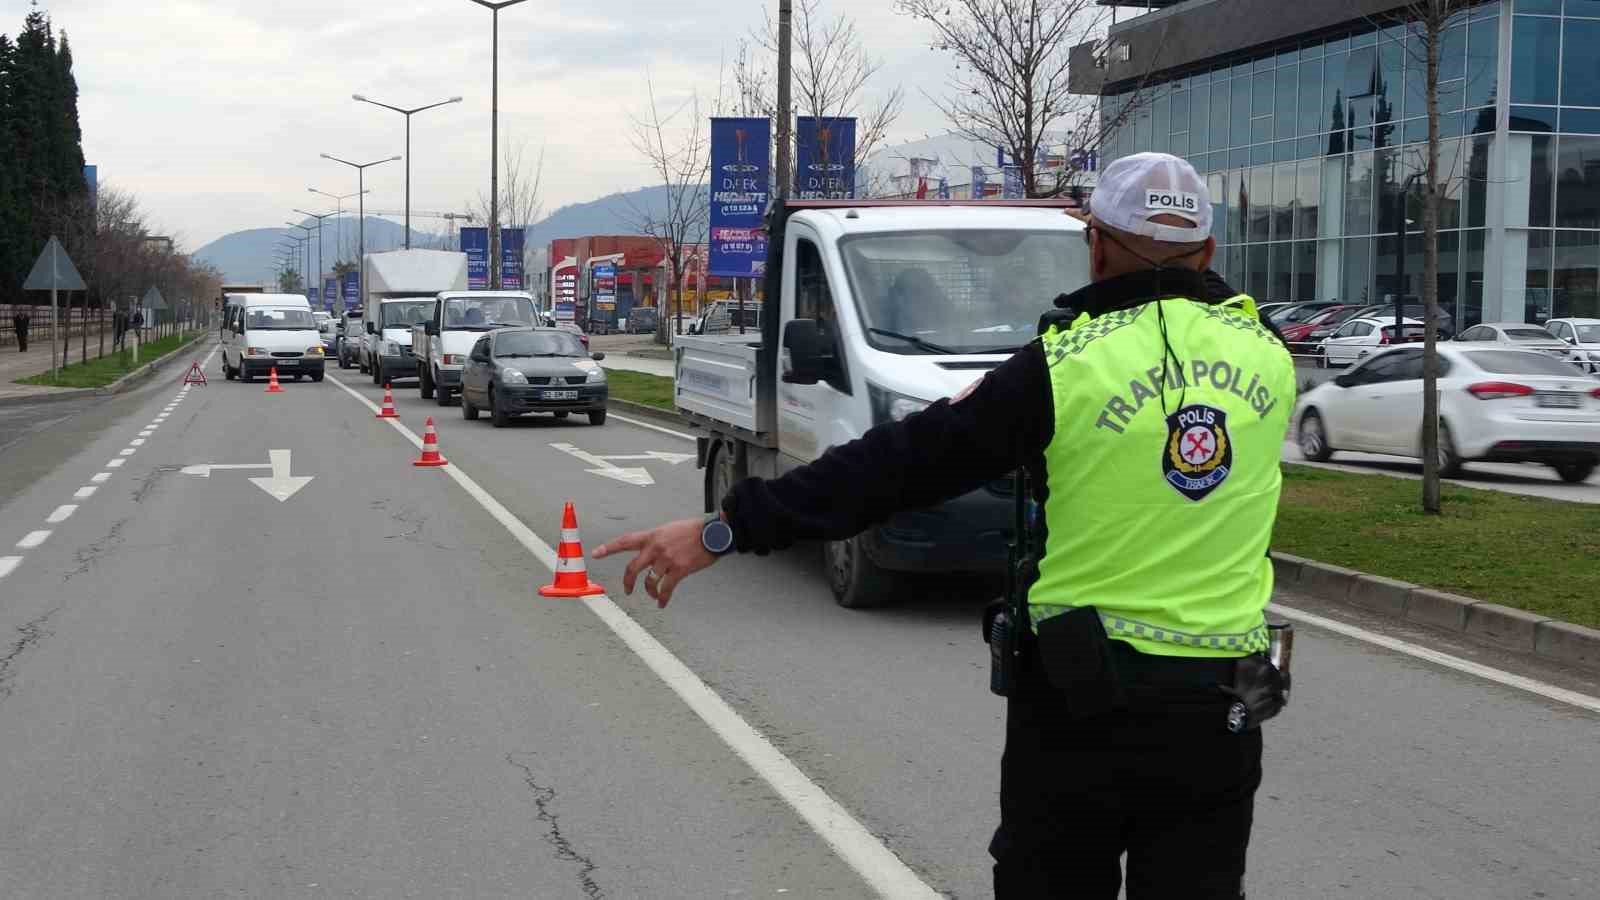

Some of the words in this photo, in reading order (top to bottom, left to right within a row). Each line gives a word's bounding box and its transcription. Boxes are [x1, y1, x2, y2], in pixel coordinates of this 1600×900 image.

[1150, 194, 1194, 209] POLİS
[1095, 357, 1191, 434] TRAFİK
[1191, 359, 1277, 420] POLİSİ
[1177, 408, 1216, 428] POLİS
